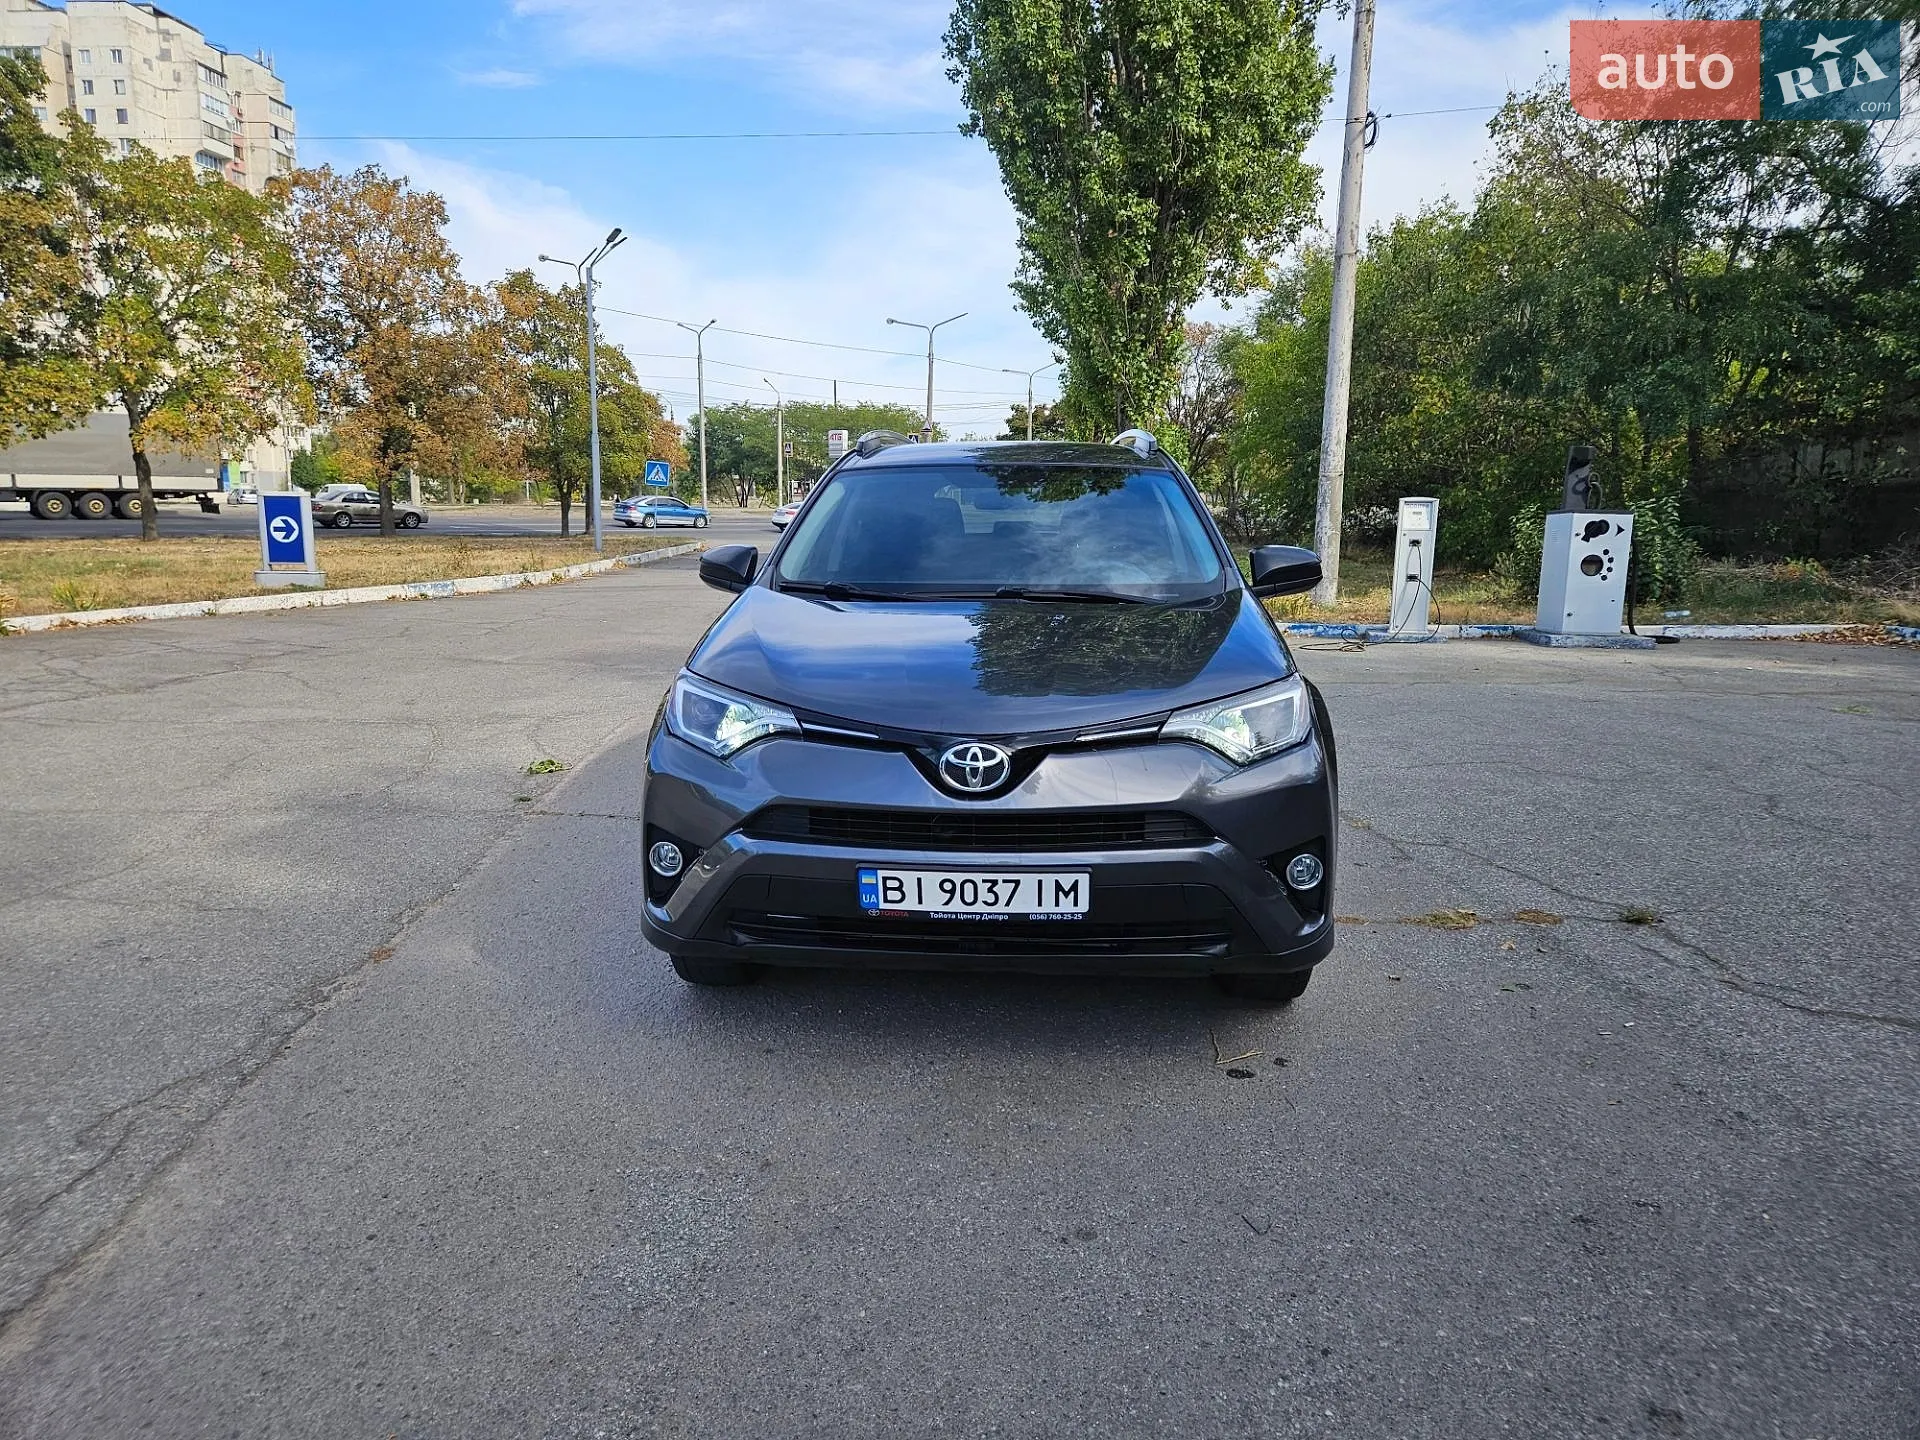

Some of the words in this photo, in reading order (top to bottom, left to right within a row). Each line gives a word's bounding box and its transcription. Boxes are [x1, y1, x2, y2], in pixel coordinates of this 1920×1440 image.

[882, 876, 924, 905] BI
[938, 878, 1022, 907] 9037
[1037, 879, 1080, 908] IM
[862, 894, 878, 903] UA
[957, 912, 980, 920] Центр
